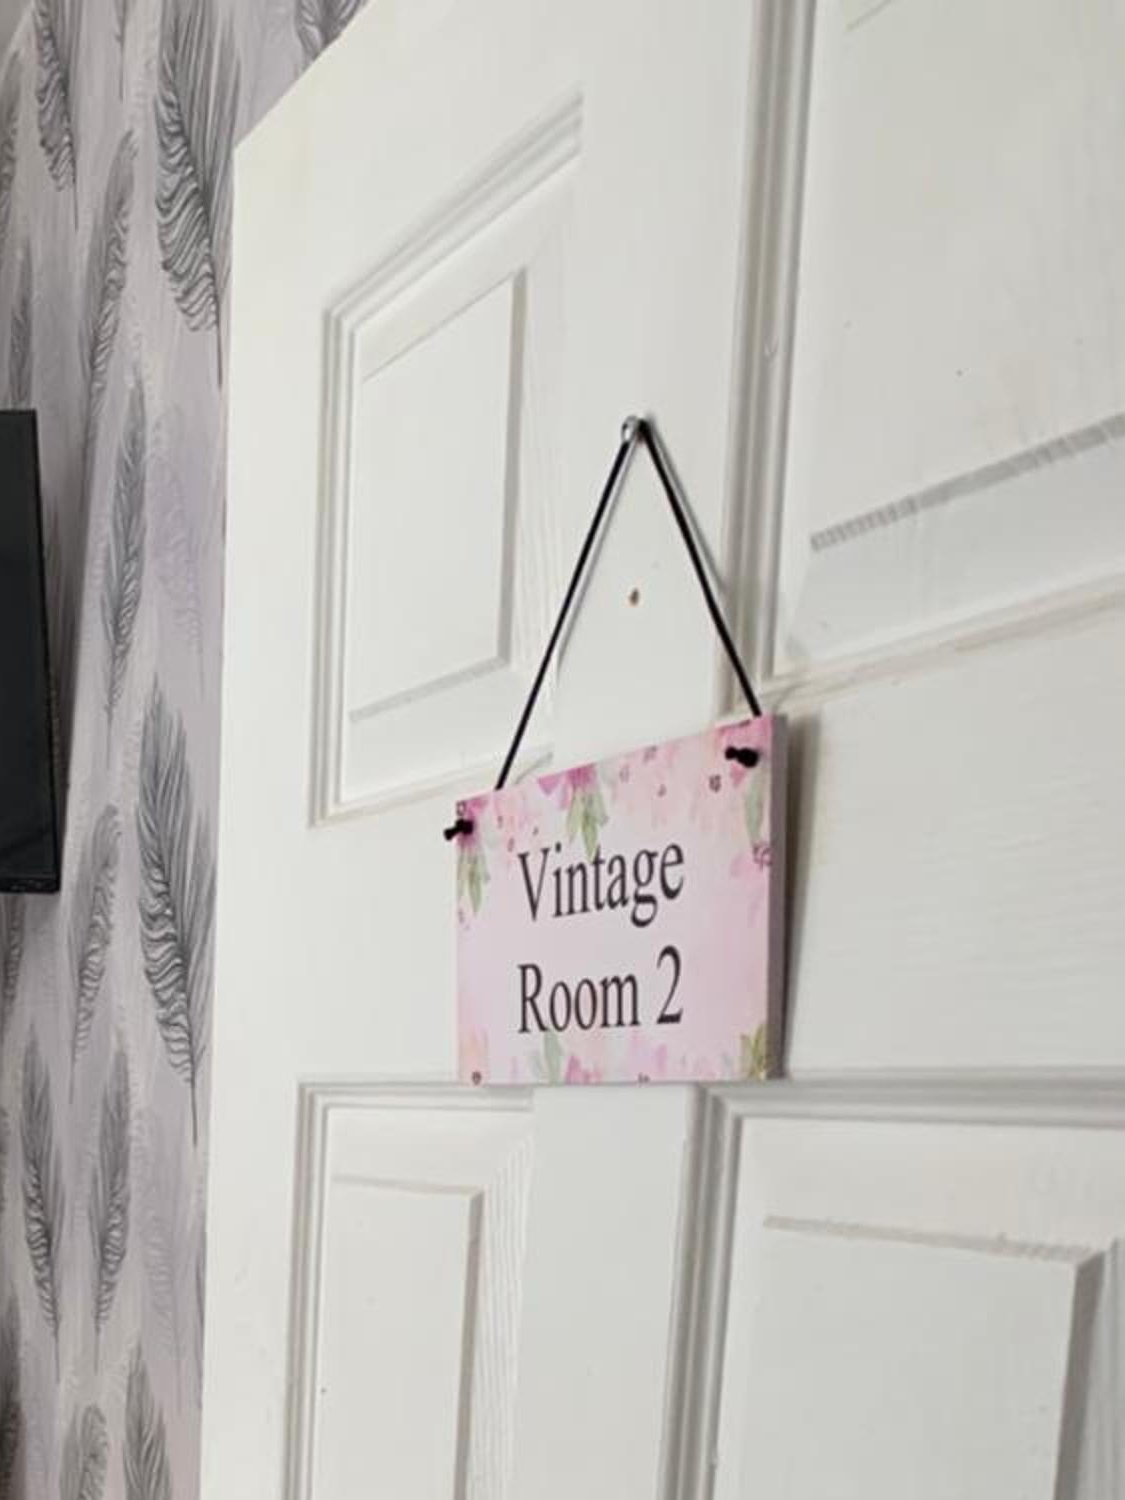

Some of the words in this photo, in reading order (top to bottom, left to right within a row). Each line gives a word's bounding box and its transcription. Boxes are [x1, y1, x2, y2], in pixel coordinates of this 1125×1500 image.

[517, 841, 685, 928] Vintage
[517, 961, 641, 1035] Room
[655, 944, 684, 1026] 2
